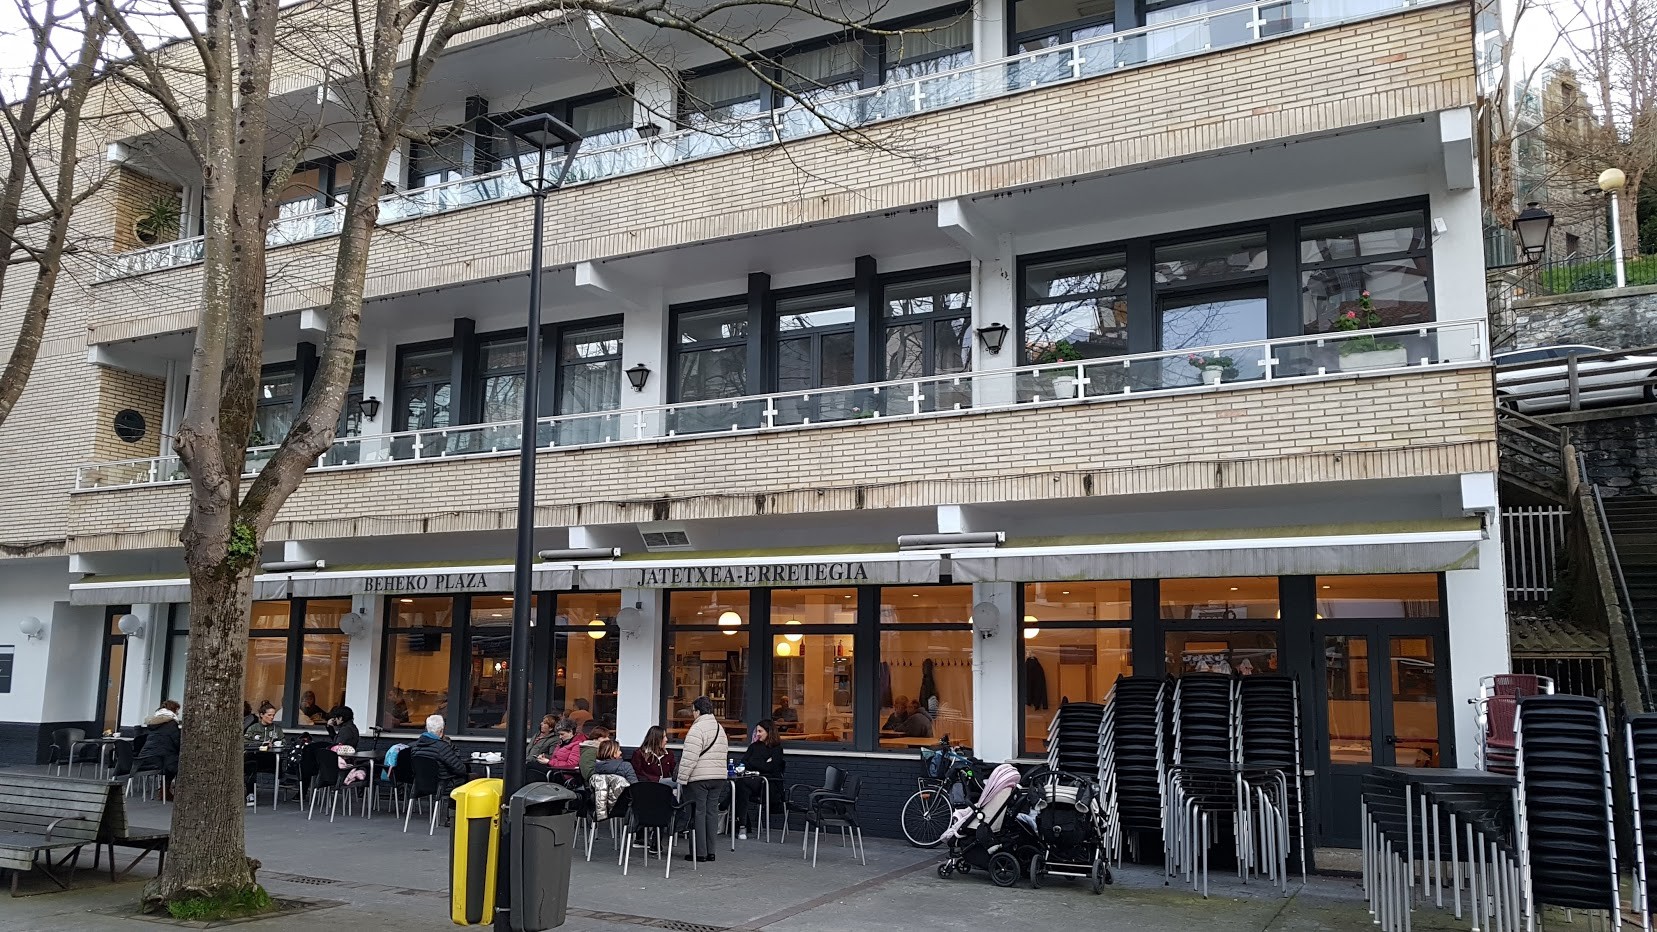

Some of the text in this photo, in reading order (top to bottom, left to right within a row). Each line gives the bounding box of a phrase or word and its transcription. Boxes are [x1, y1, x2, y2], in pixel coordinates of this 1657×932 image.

[364, 573, 488, 592] BEHEKO PLAZA
[637, 562, 869, 586] JATETXEA-ERRETEGIA
